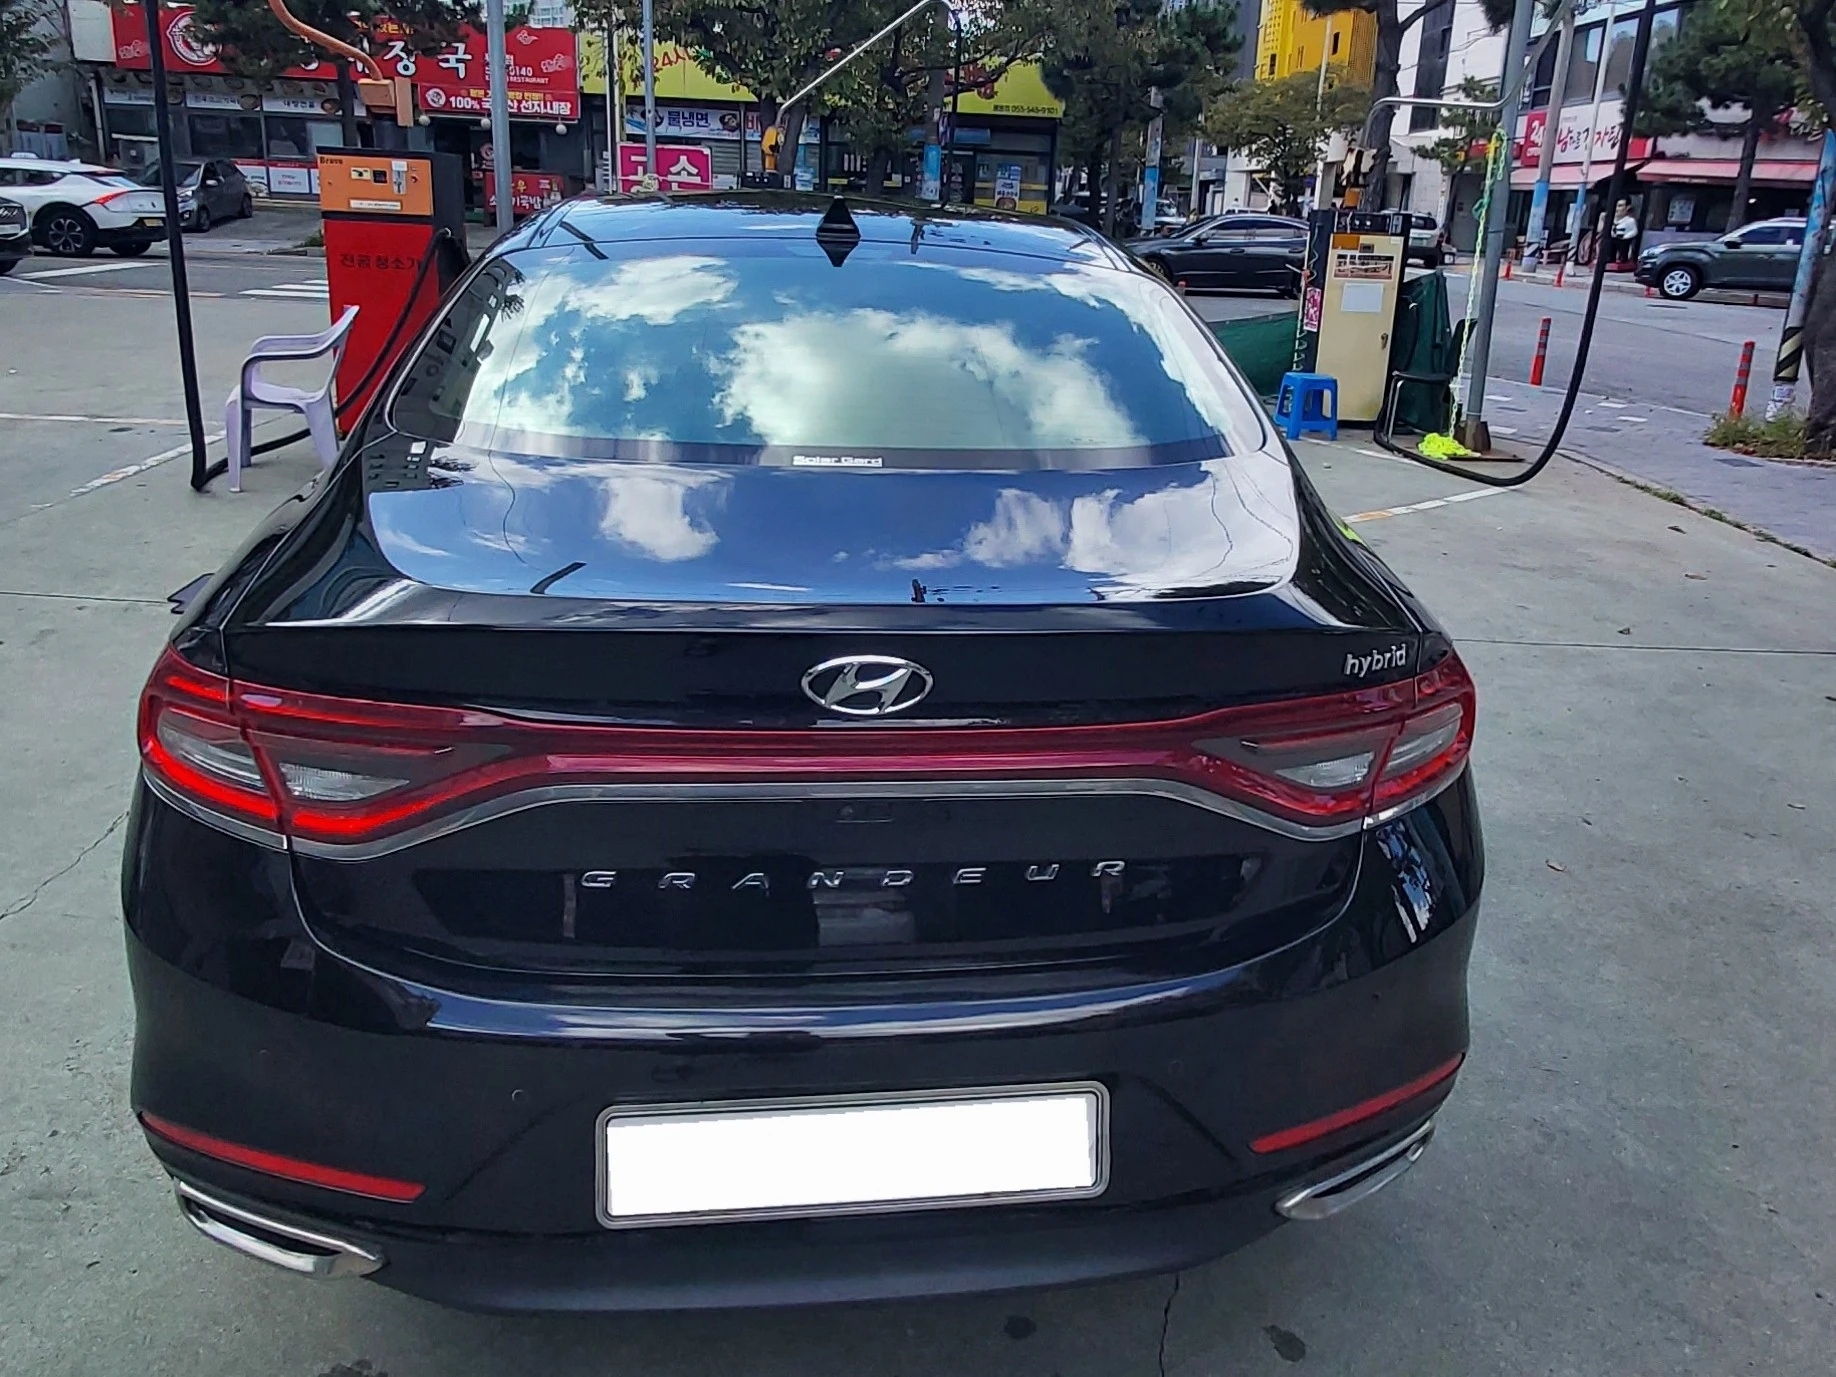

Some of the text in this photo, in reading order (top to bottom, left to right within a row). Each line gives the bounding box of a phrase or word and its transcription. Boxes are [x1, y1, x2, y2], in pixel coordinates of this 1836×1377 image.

[449, 95, 480, 109] 100%
[481, 97, 520, 112] 국산
[488, 195, 542, 210] 소기국밥
[1343, 643, 1407, 678] hybrid
[581, 859, 1126, 893] GRANDEUR
